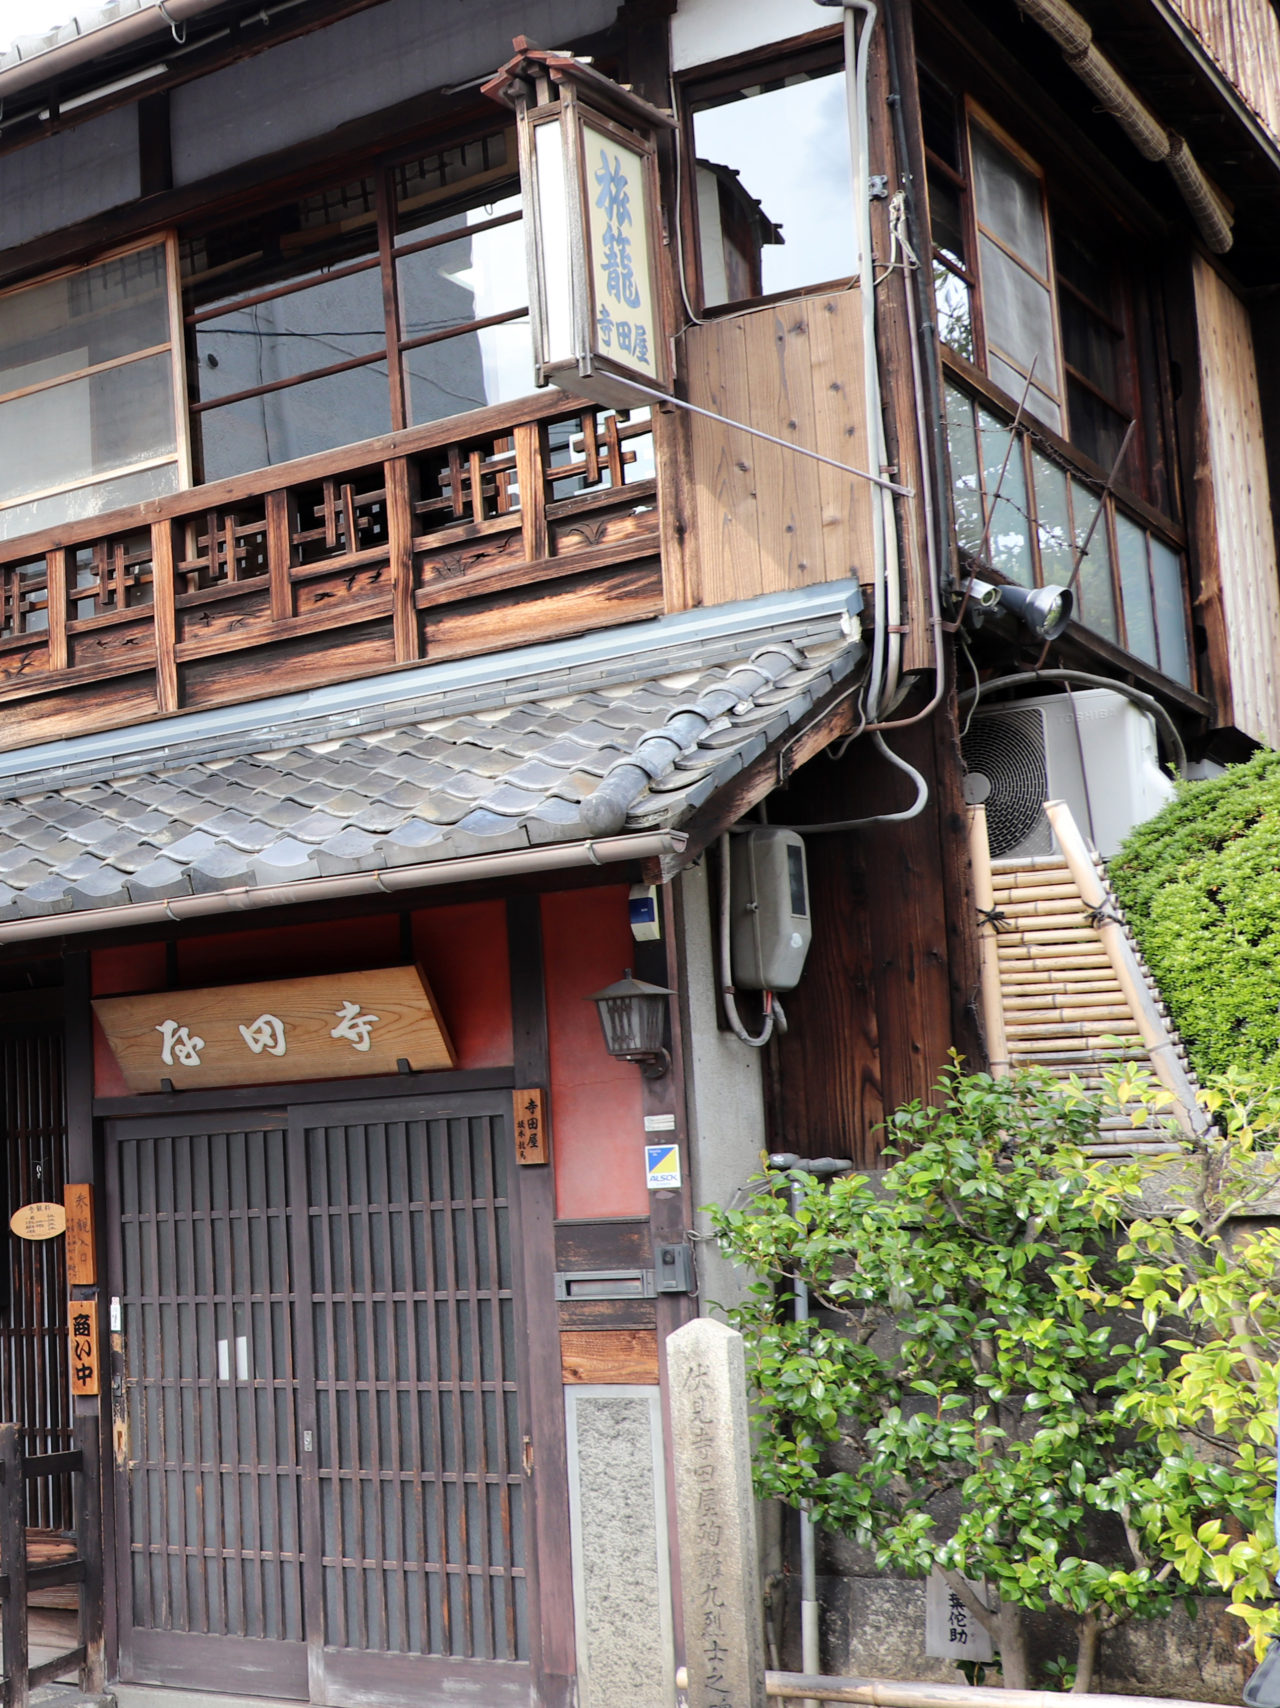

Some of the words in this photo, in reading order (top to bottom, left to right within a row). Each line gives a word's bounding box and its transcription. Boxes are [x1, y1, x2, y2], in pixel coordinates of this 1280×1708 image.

[595, 149, 641, 309] 旅籠
[597, 304, 650, 366] 寺田屋
[1057, 708, 1117, 724] TOSHIBA
[525, 1098, 538, 1148] 寺田屋
[73, 1313, 93, 1386] 商い中
